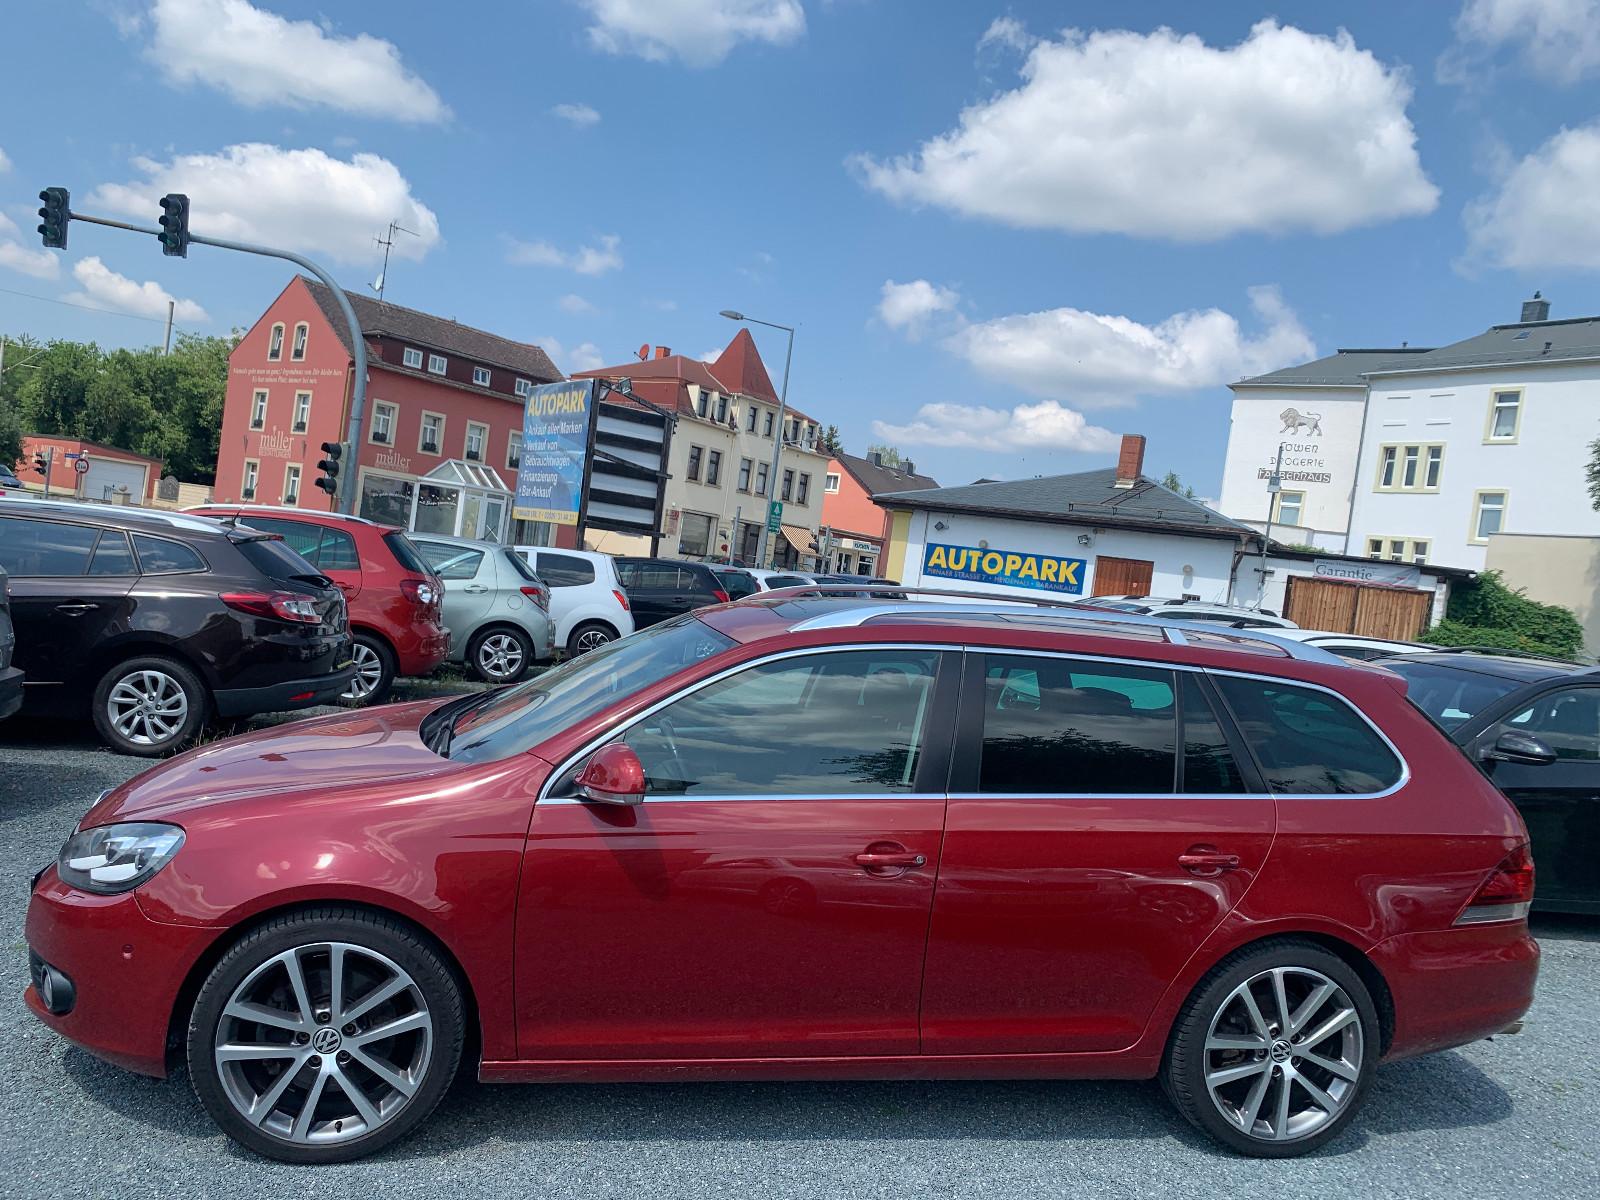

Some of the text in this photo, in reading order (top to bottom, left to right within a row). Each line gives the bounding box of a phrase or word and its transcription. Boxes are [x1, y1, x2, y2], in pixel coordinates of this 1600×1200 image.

[527, 389, 587, 416] AUTOPARK
[529, 421, 583, 436] Ankauf aller Marken
[527, 439, 558, 451] Verkauf von
[525, 455, 570, 470] Gebrauchtwagen
[523, 470, 558, 486] Finanzierung
[521, 485, 553, 498] Bar-Ankauf
[927, 546, 1080, 585] AUTOPARK
[1315, 564, 1373, 580] Garantie
[927, 567, 953, 578] PIRNAER
[954, 570, 982, 581] STRASSE
[1035, 580, 1078, 593] BARANKAUF
